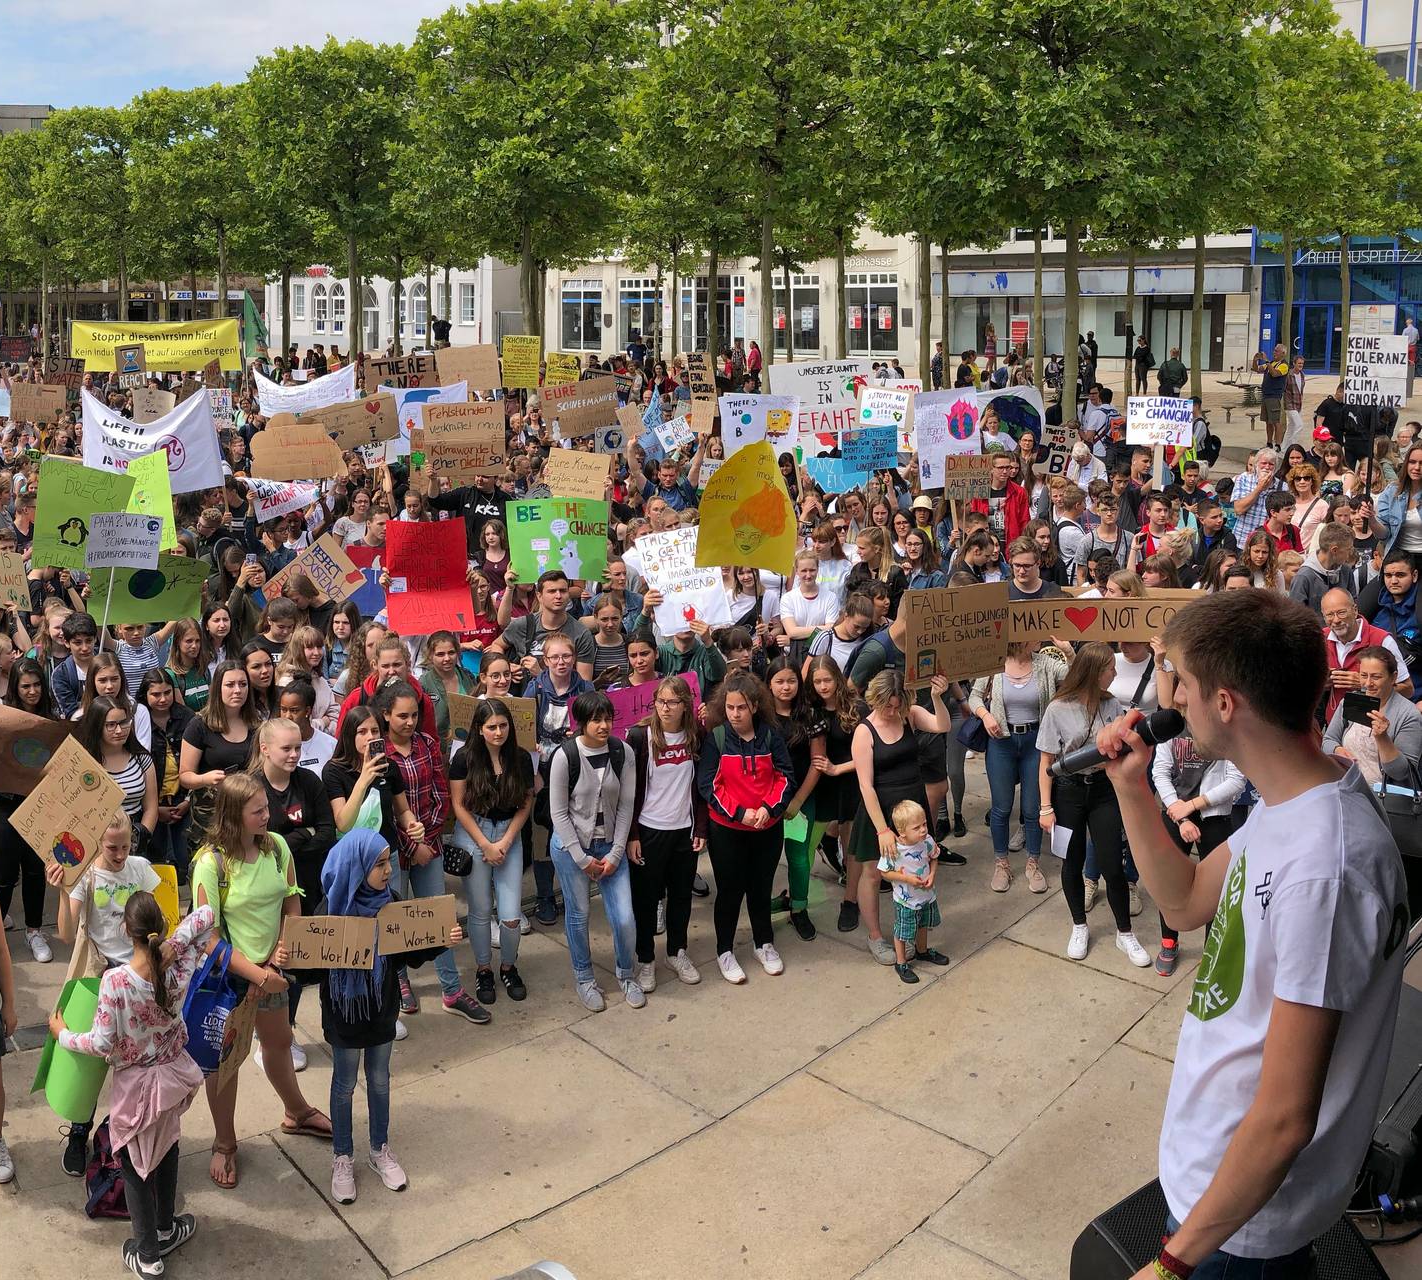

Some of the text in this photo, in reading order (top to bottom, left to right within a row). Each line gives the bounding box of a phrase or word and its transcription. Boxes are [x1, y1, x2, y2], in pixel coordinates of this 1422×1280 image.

[91, 331, 125, 342] Stoppt
[129, 331, 160, 342] diesen
[196, 330, 217, 341] hier!
[1347, 336, 1381, 350] KEINE
[75, 345, 237, 359] Kein auf unseren Bergen!
[1347, 350, 1407, 365] TOLERANZ
[62, 358, 85, 373] THE
[371, 357, 426, 376] THERE
[1346, 364, 1368, 378] FÜR
[118, 371, 147, 390] REACT
[817, 380, 830, 391] IS
[1344, 379, 1379, 393] KLIMA
[544, 384, 577, 401] EURE
[817, 393, 833, 405] IN
[1344, 392, 1402, 408] IGNORANZ
[1146, 397, 1189, 410] CLIMATE
[429, 404, 493, 421] Fehlstunden
[731, 409, 744, 417] NO
[1145, 409, 1193, 423] CHANGING
[102, 419, 130, 434] LIFE
[735, 427, 743, 438] B
[102, 454, 114, 466] IS
[516, 501, 588, 523] BE THE
[125, 517, 147, 529] WAS
[568, 520, 607, 537] CHANGE
[641, 532, 670, 548] THIS
[912, 591, 957, 613] FÄLLT
[923, 605, 1010, 631] ENTSCHEIDUNGEN
[1013, 605, 1137, 632] MAKE NOT
[915, 626, 991, 645] KEINE BÄUME
[1228, 862, 1242, 910] FOR
[401, 904, 435, 919] Taten
[306, 922, 335, 937] Save
[288, 942, 310, 961] the
